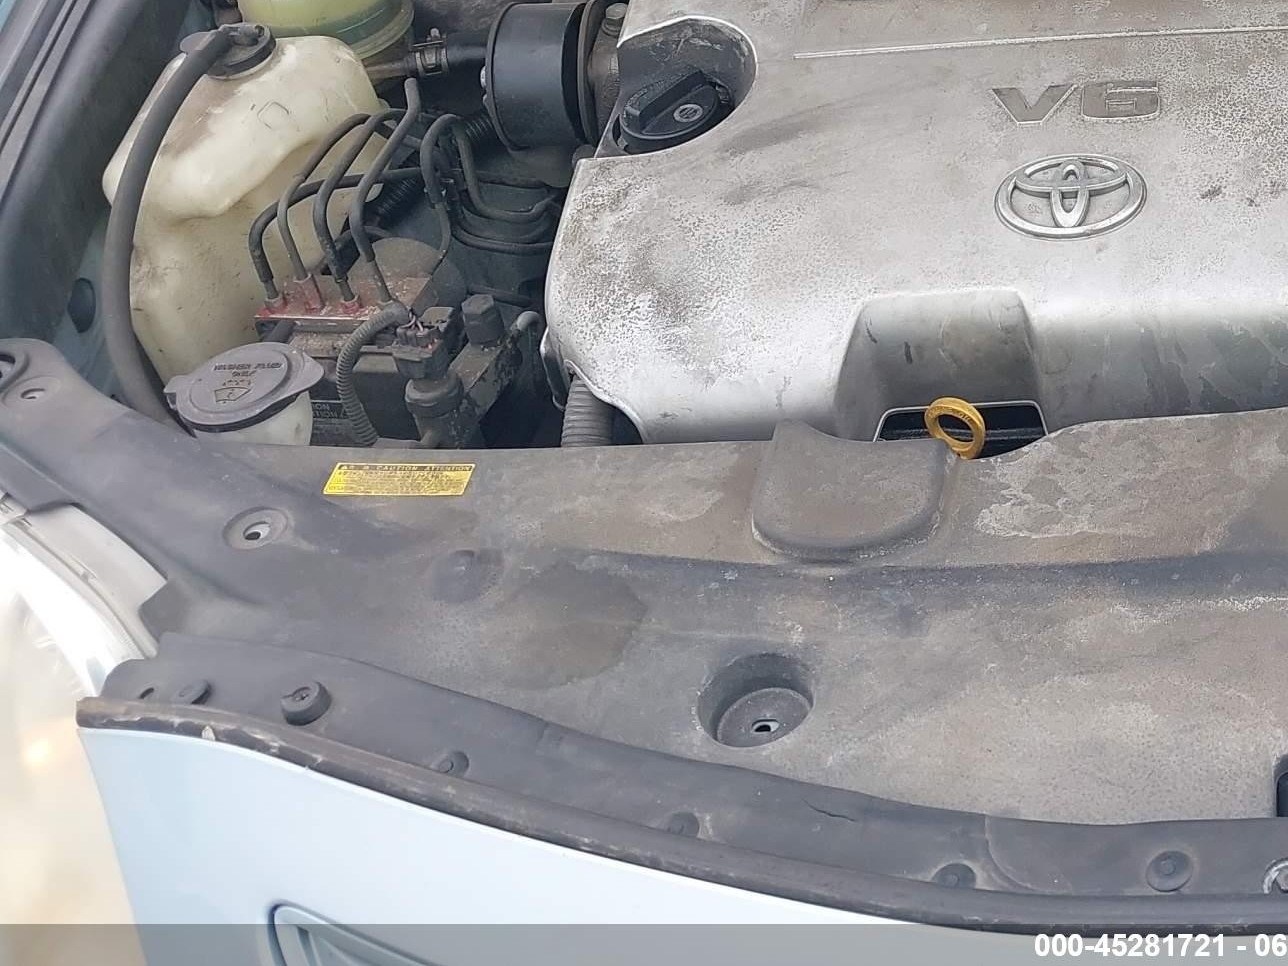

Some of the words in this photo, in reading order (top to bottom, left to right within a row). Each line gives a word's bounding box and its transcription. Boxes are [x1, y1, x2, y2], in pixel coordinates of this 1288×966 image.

[991, 80, 1161, 125] V6
[377, 464, 418, 472] CAUTION
[424, 464, 471, 472] ATTENTION
